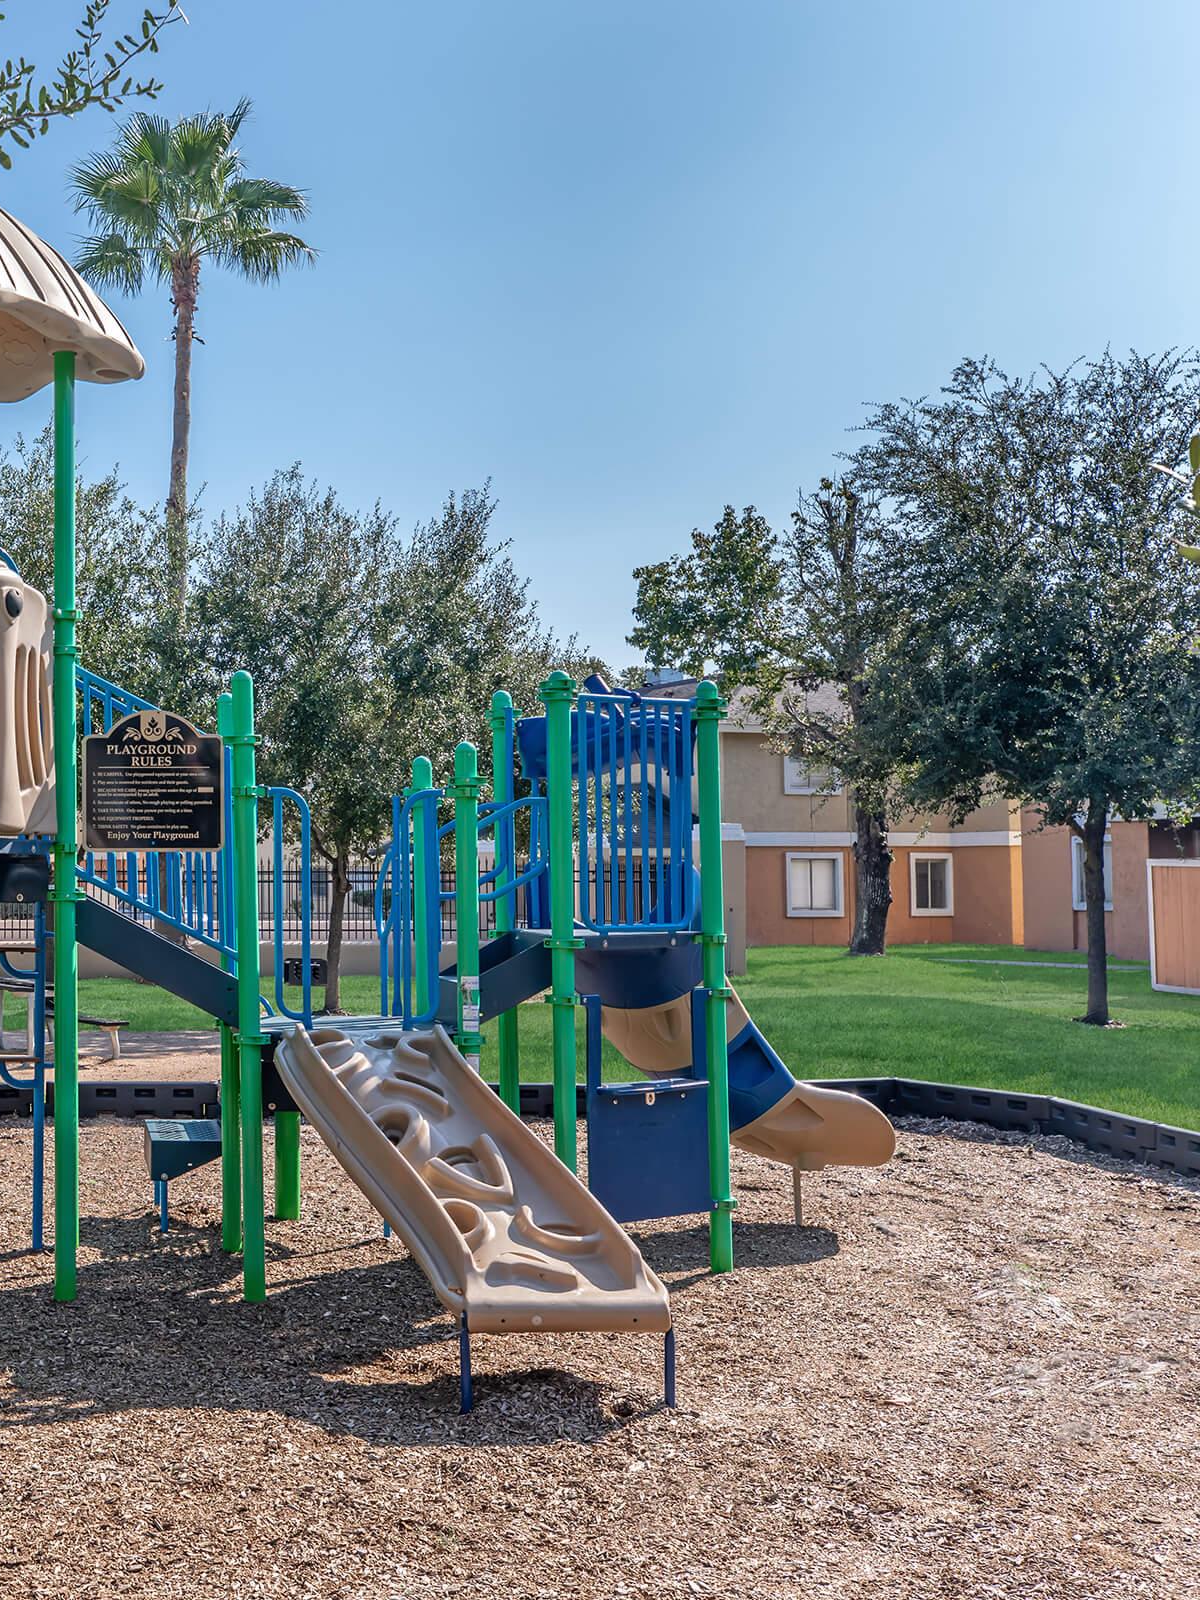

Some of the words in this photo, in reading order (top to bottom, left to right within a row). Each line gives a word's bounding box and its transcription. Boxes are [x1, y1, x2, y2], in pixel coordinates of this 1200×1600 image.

[106, 745, 197, 754] PLAYGROUND
[131, 756, 173, 766] RULES
[107, 832, 131, 841] Enjoy
[132, 831, 151, 839] Your
[153, 831, 200, 841] Playground
